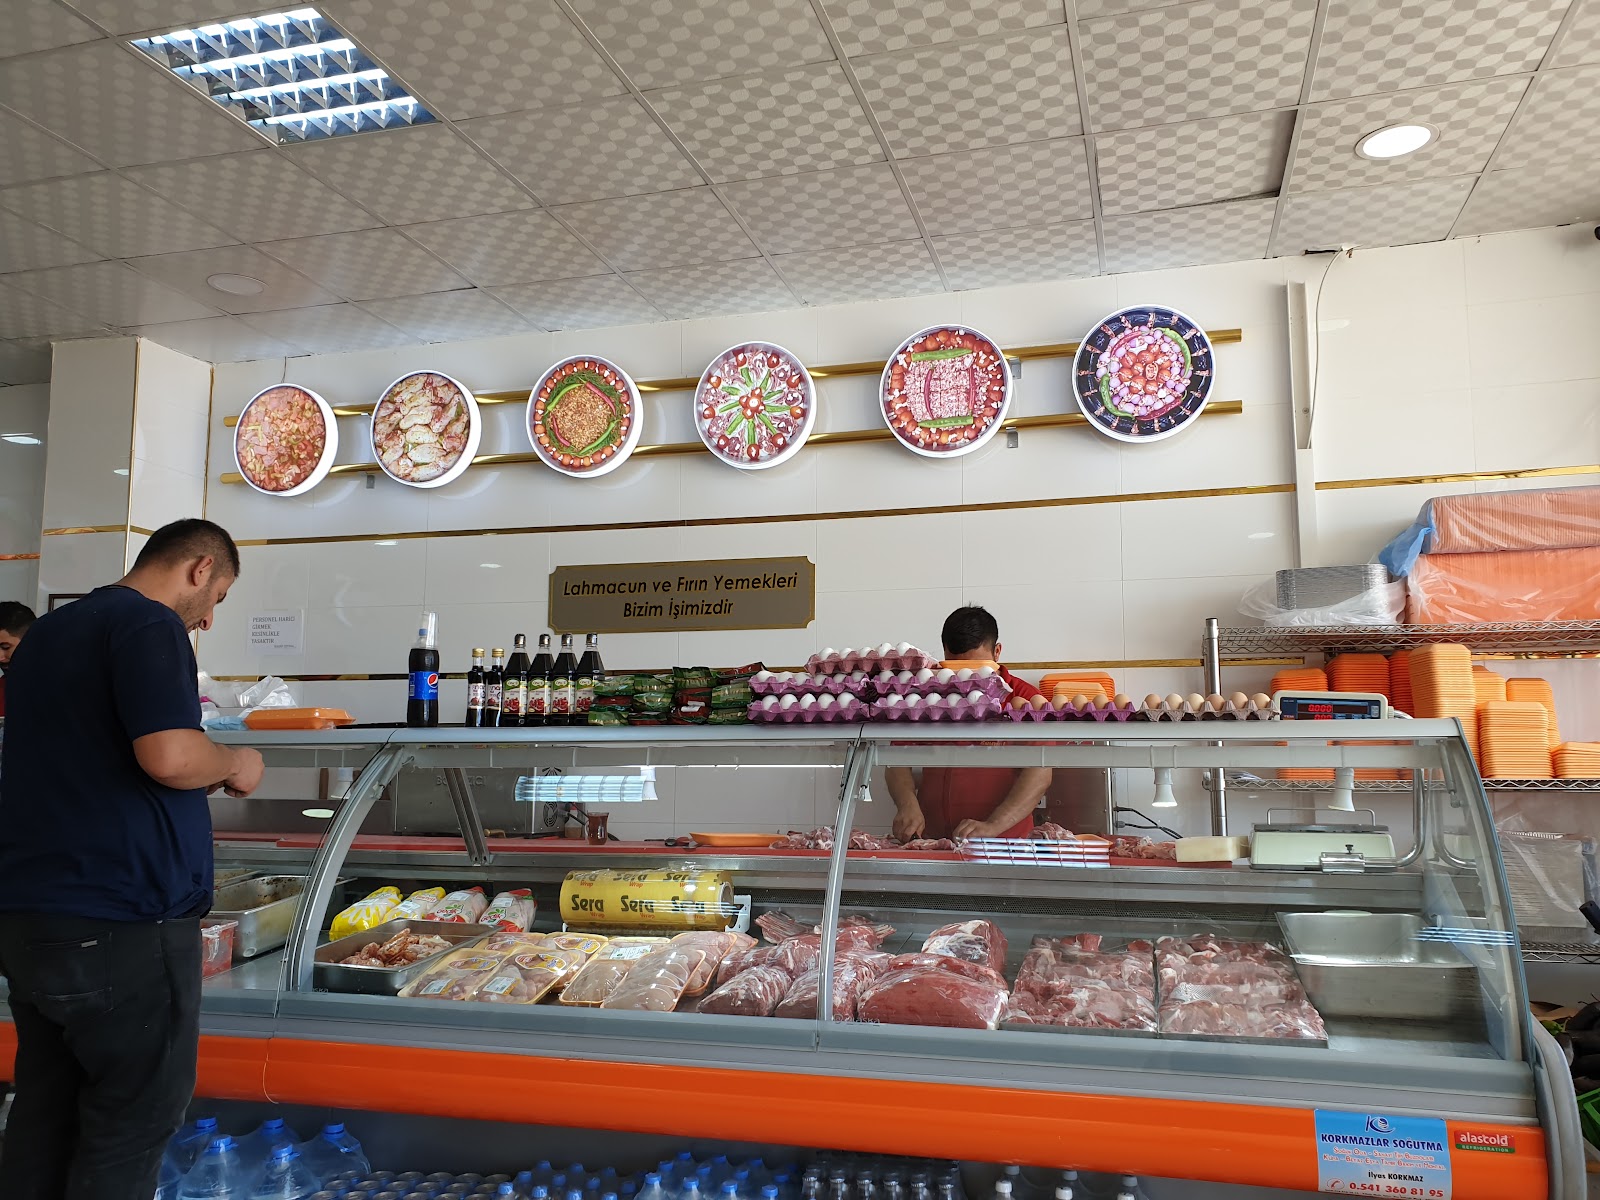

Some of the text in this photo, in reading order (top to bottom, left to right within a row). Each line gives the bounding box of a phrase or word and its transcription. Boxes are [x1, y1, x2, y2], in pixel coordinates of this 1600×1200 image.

[563, 572, 798, 596] Lahmacun ve Fırın Yemekleri
[623, 598, 734, 619] Bizim İşimizdir
[571, 894, 605, 912] Sera
[620, 894, 656, 913] Sera
[1321, 1133, 1444, 1152] KORKMAZLAR SOĞUTMA
[1460, 1132, 1508, 1146] alascold
[1462, 1144, 1509, 1152] REFRIGERATION
[1368, 1170, 1424, 1182] İlyas KORKMAZ
[1349, 1182, 1380, 1192] 0.541
[1385, 1185, 1407, 1194] 360
[1411, 1186, 1424, 1196] 81
[1429, 1189, 1444, 1198] 95
